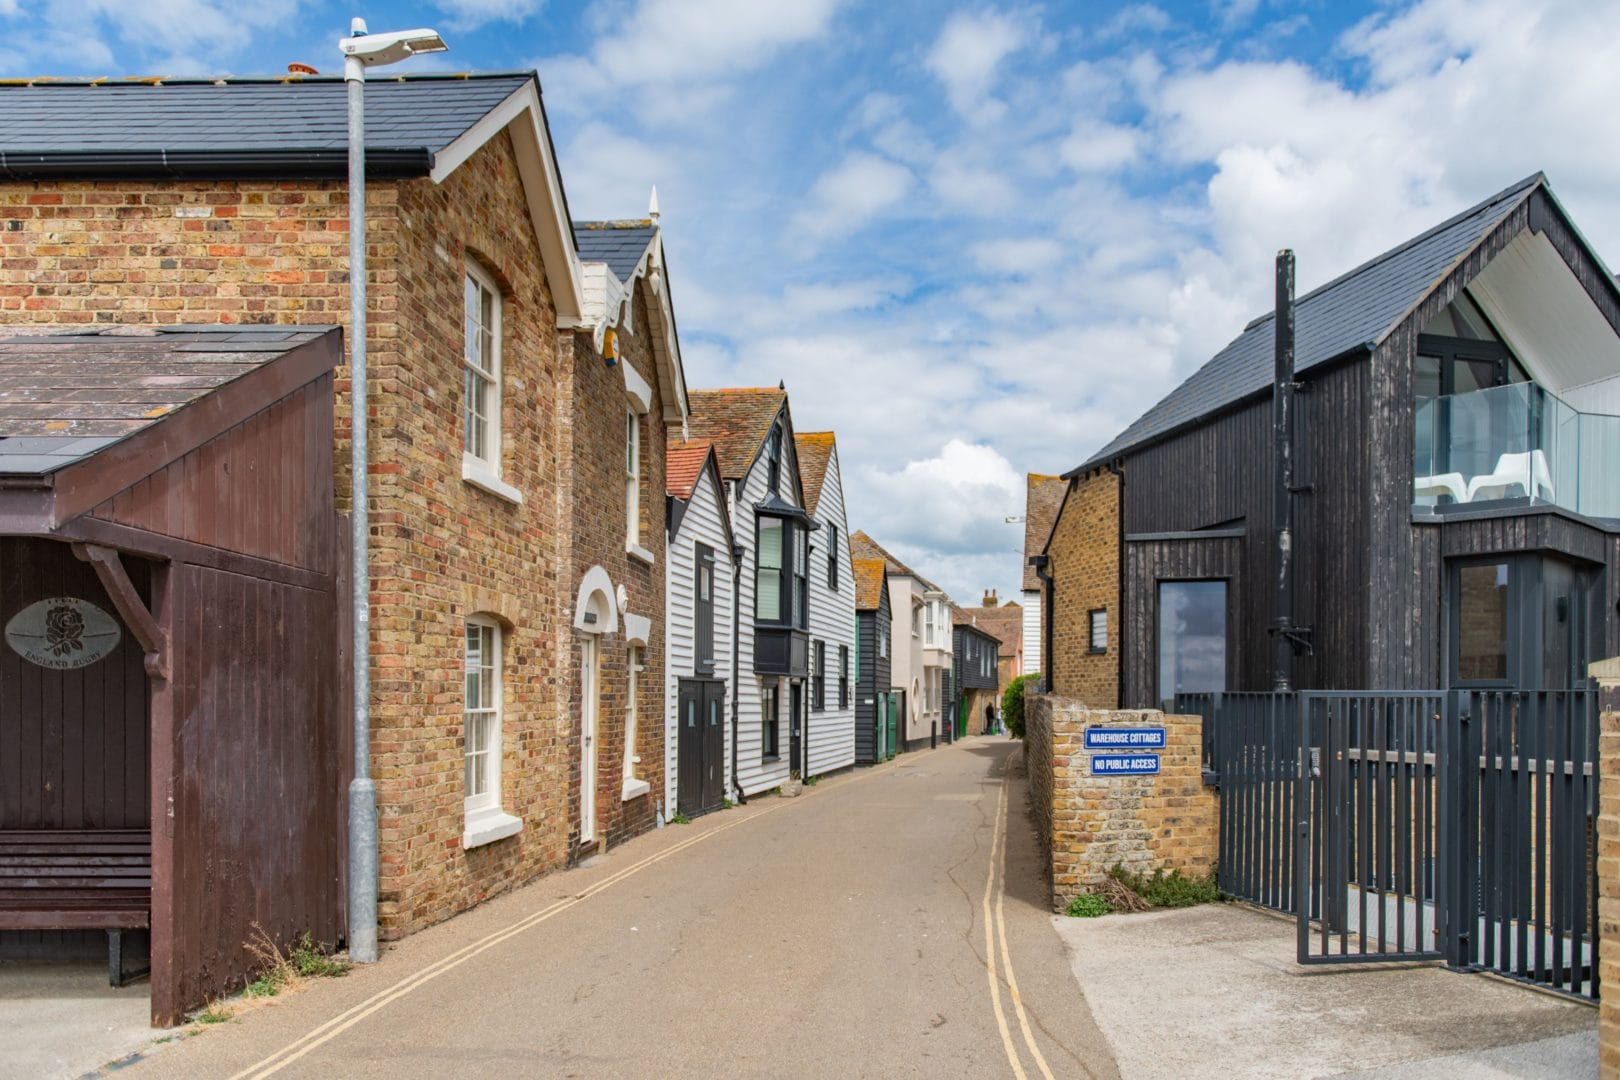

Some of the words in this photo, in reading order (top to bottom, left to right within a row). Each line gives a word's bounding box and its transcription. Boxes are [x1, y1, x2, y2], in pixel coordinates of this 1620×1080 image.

[26, 651, 68, 667] ENGLAND
[73, 651, 101, 666] RUGBY
[1090, 733, 1129, 743] WAREHOUSE
[1130, 733, 1161, 743] COTTAGES
[1095, 759, 1105, 769] NO
[1106, 759, 1130, 769] PUBLIC
[1131, 759, 1156, 769] ACCESS
